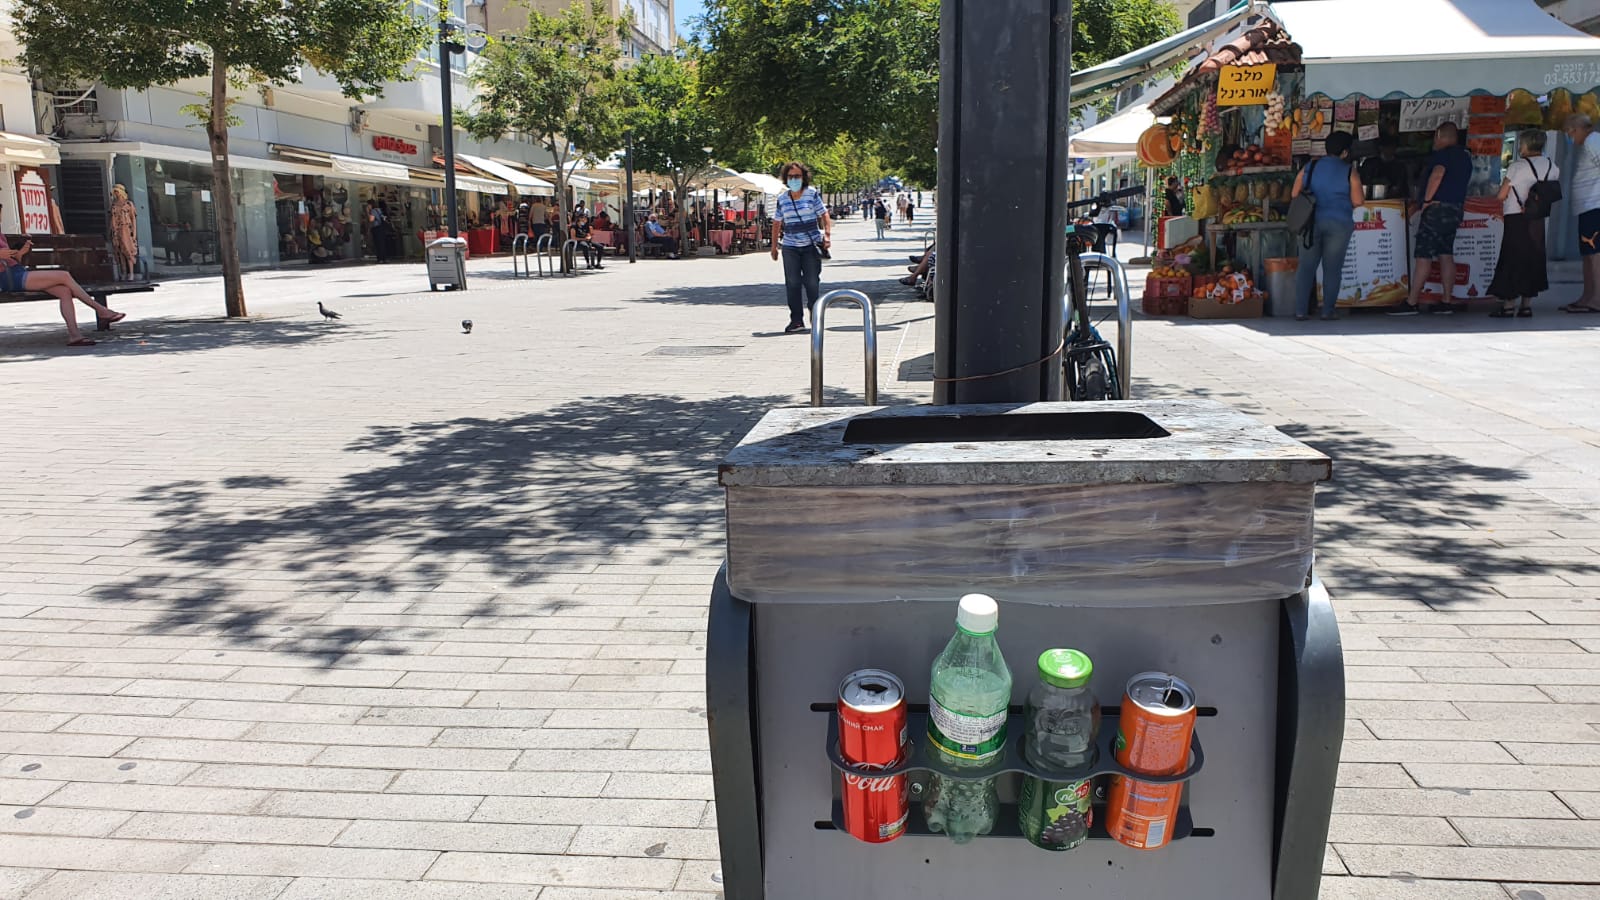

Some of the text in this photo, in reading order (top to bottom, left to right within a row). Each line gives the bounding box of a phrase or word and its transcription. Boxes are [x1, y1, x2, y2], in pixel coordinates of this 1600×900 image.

[1231, 69, 1263, 82] מלבי
[1220, 87, 1268, 99] אורגינל
[862, 724, 884, 732] СМАК
